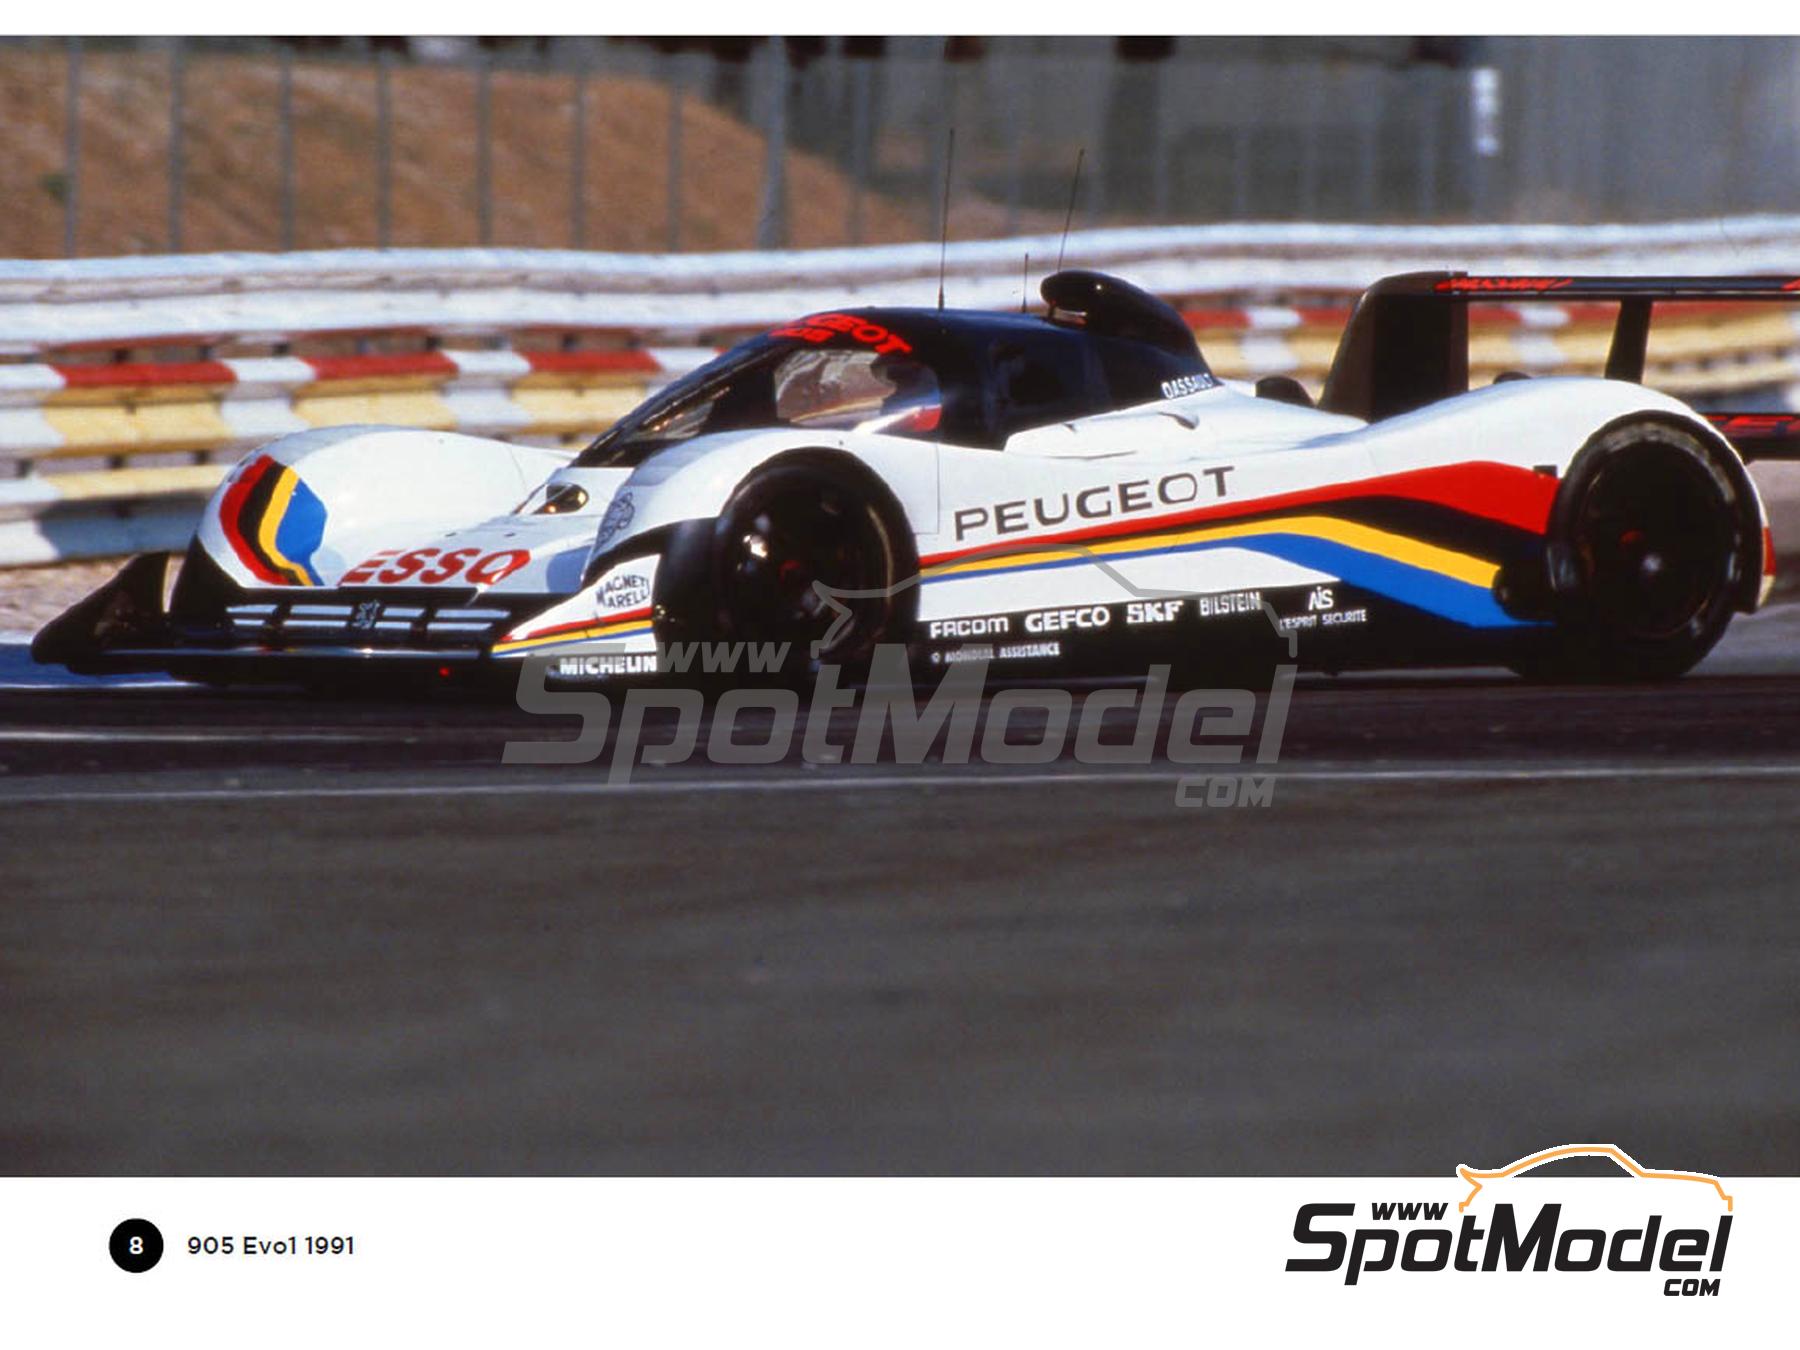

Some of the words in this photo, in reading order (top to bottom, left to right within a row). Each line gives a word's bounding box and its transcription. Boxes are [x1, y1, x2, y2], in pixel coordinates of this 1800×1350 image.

[954, 465, 1235, 541] PEUGEOT
[337, 547, 531, 586] ESSO
[1127, 599, 1183, 624] SKF
[1200, 591, 1262, 616] BILSTEIN
[929, 616, 1009, 639] FACOM
[1024, 606, 1111, 633] GEFCO
[999, 641, 1061, 659] ASSISTANCE
[560, 656, 658, 675] MICHELIN
